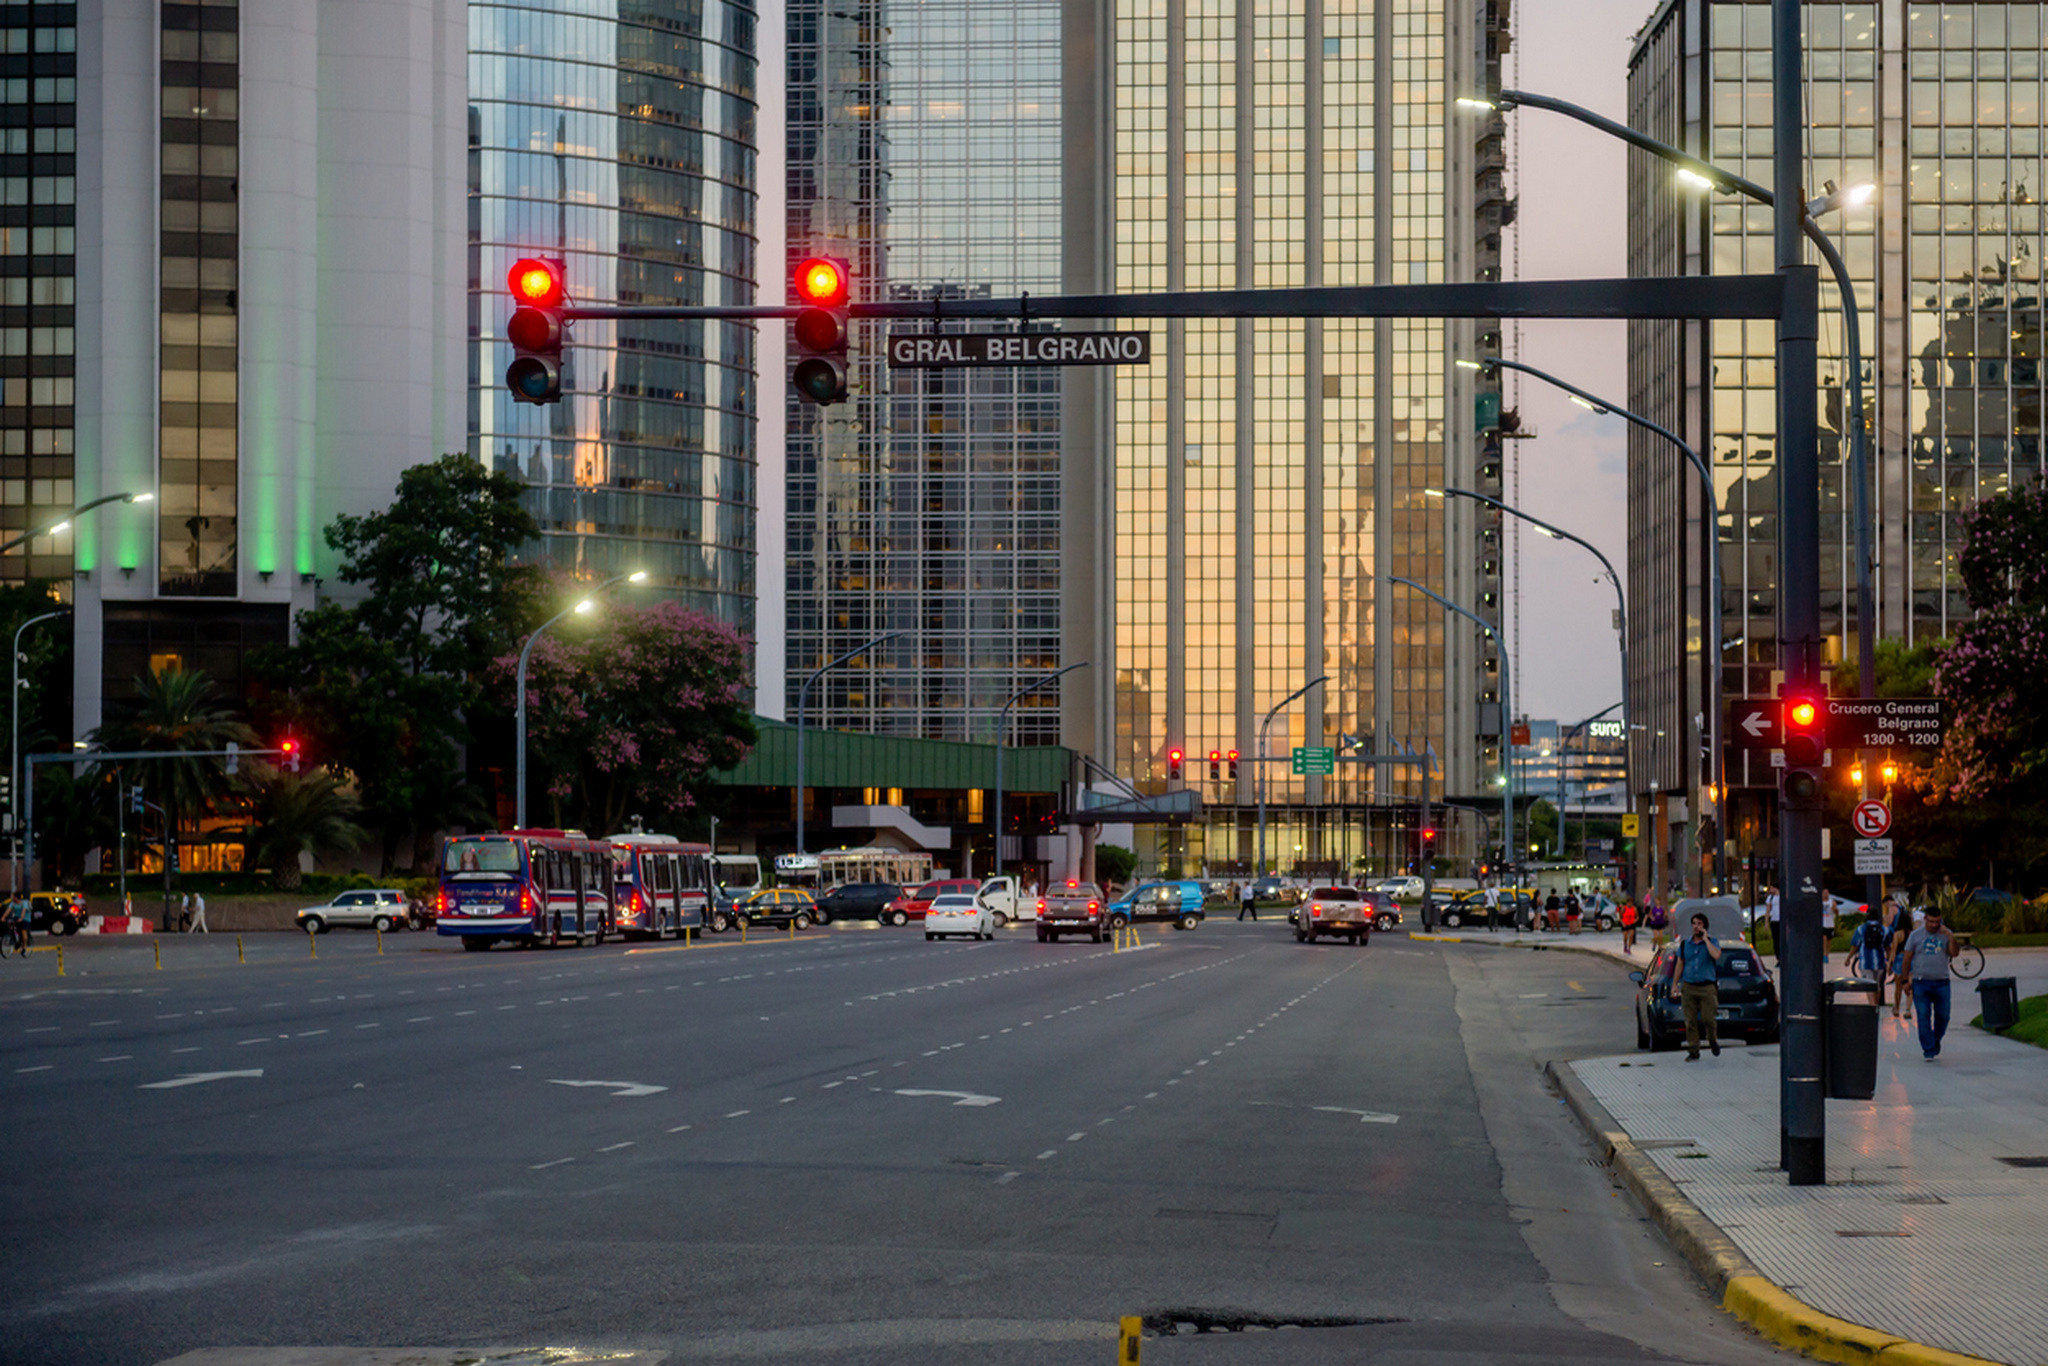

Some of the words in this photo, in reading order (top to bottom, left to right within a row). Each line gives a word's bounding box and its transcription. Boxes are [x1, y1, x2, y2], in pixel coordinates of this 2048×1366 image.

[894, 339, 977, 362] GRAL.
[986, 336, 1143, 361] BELGRANO
[1828, 702, 1882, 714] Crucero
[1885, 702, 1940, 714] General
[1877, 717, 1940, 731] Belgrano
[1863, 733, 1895, 745] 1300
[1907, 733, 1940, 745] 1200
